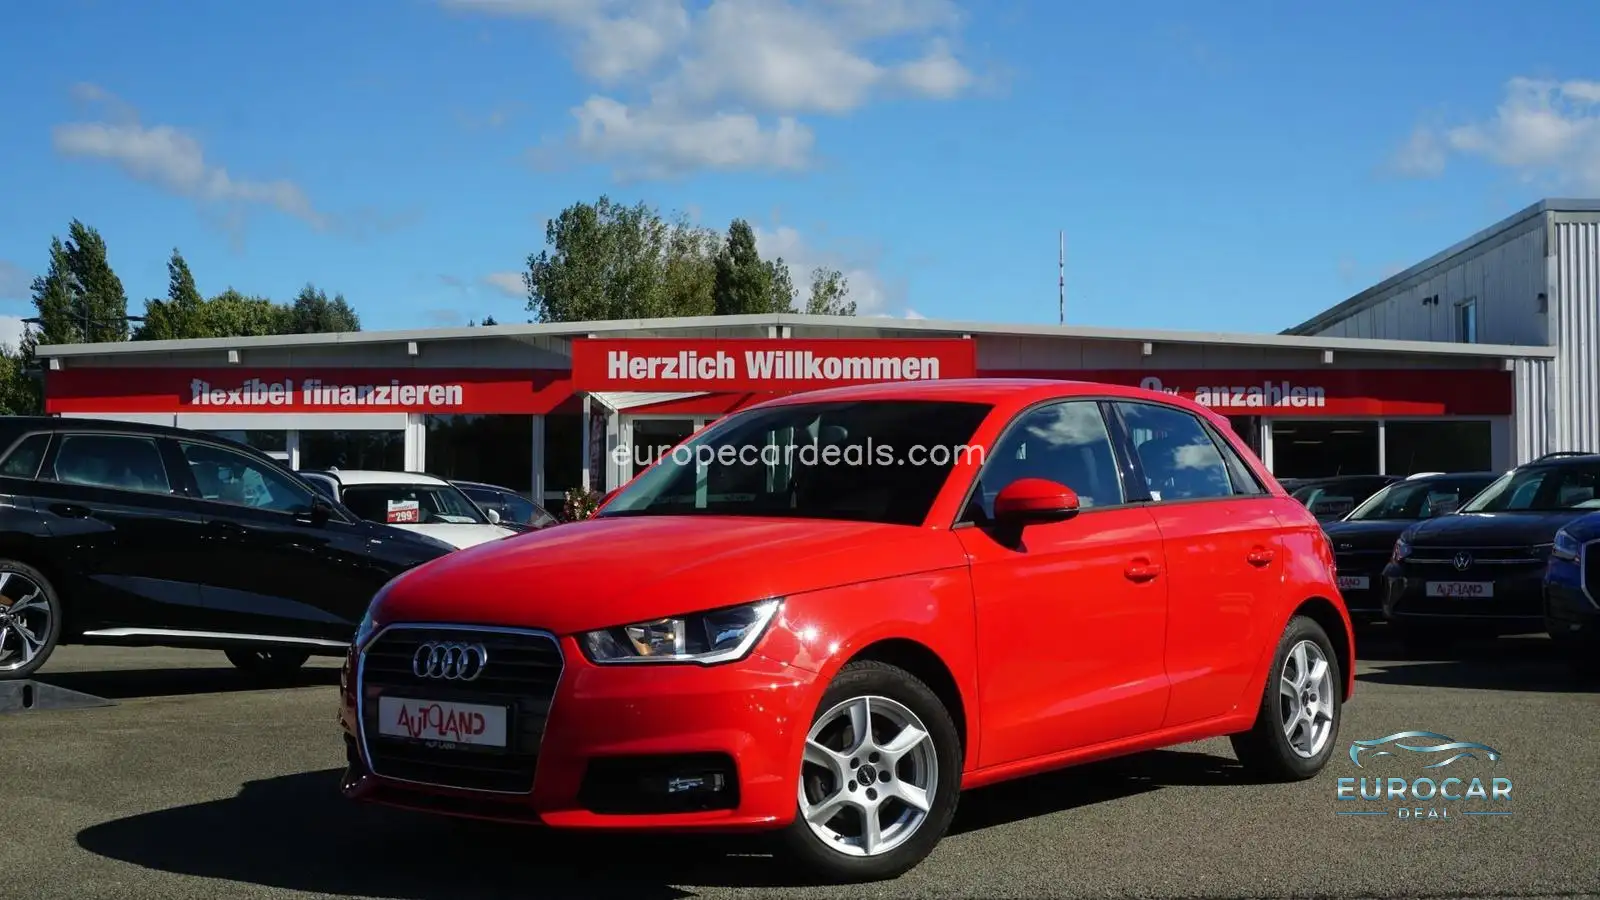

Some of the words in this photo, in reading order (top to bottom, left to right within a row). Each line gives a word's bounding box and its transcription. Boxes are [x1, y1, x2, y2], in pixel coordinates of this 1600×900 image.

[608, 351, 735, 379] Herzlich
[745, 351, 940, 379] Willkommen
[190, 378, 293, 405] flexibel
[302, 379, 463, 405] finanzieren
[1195, 380, 1325, 407] anzahlen
